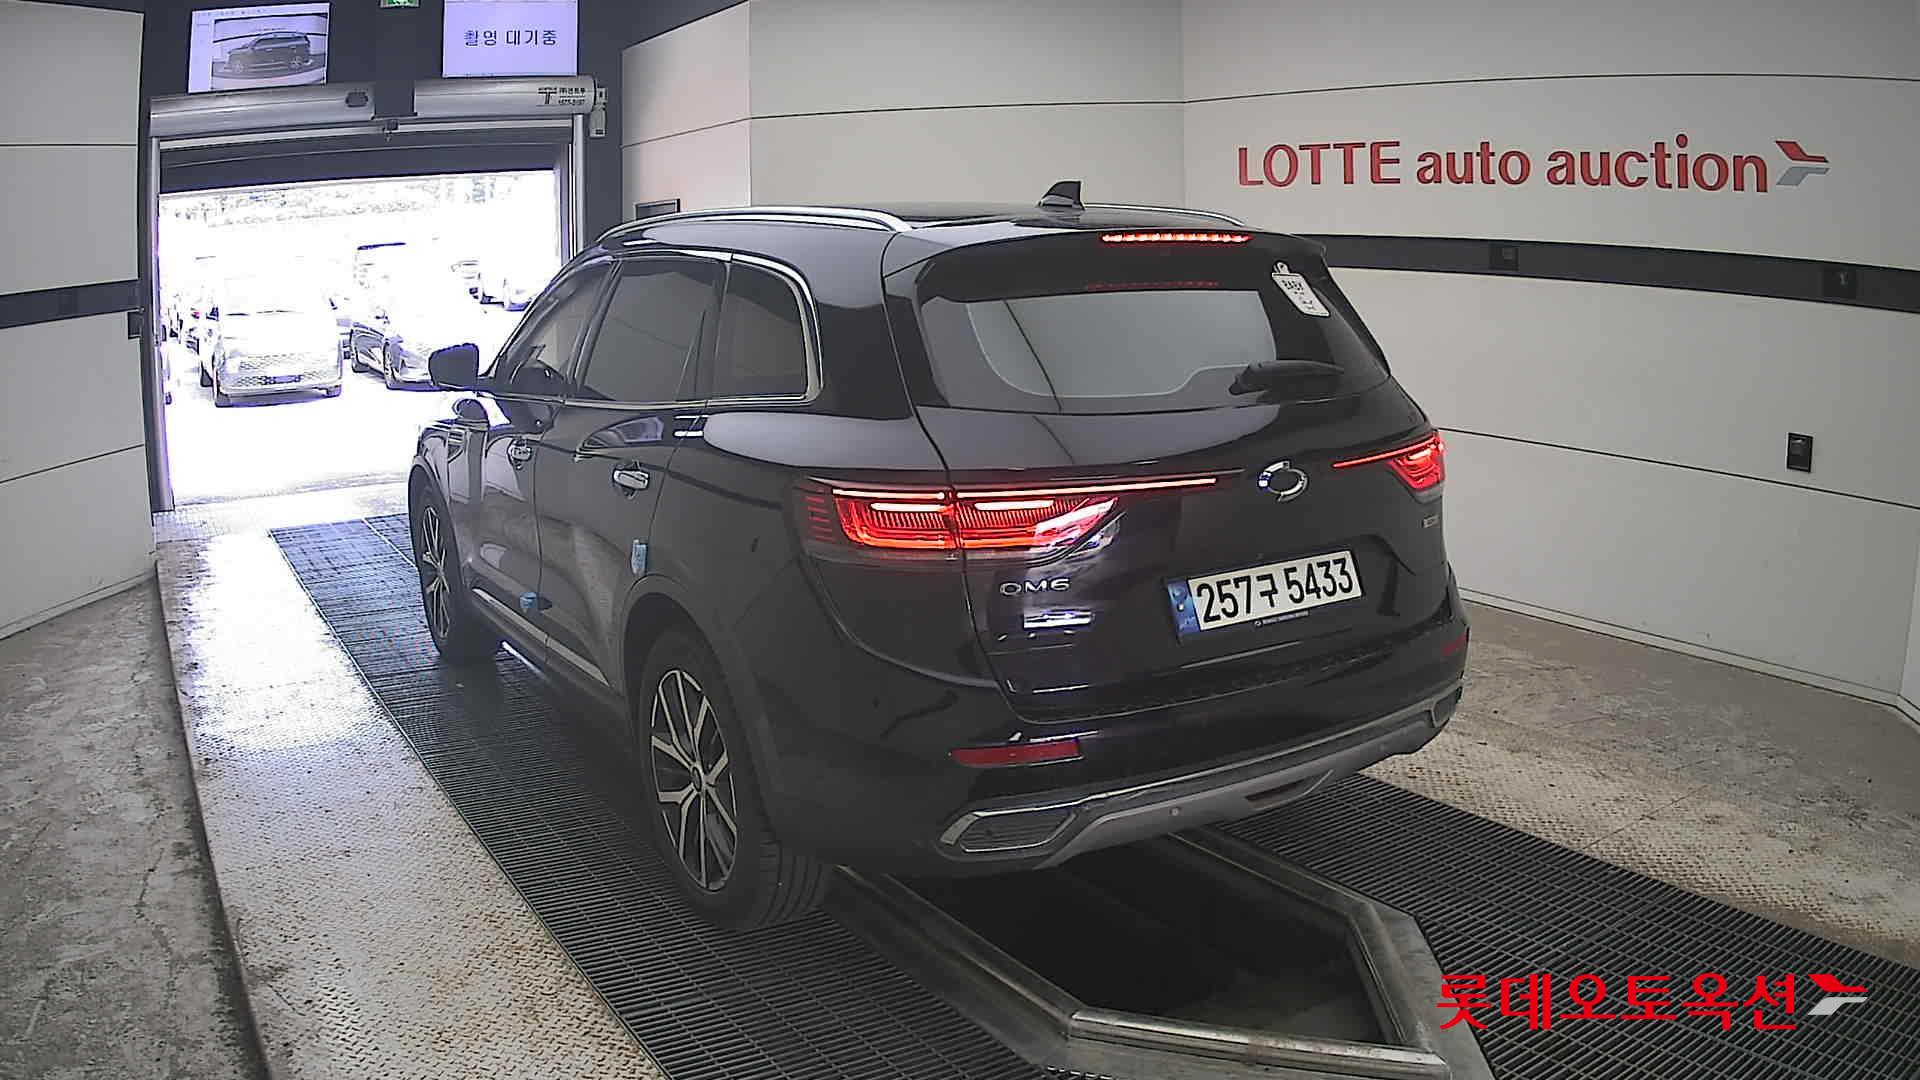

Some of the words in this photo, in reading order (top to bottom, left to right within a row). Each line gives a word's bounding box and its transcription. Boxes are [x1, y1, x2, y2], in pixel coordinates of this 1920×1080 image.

[506, 29, 557, 46] 대기중
[1238, 141, 1401, 187] LOTTE
[1416, 141, 1531, 186] auto
[1546, 134, 1768, 193] auction
[1283, 557, 1352, 604] 5433
